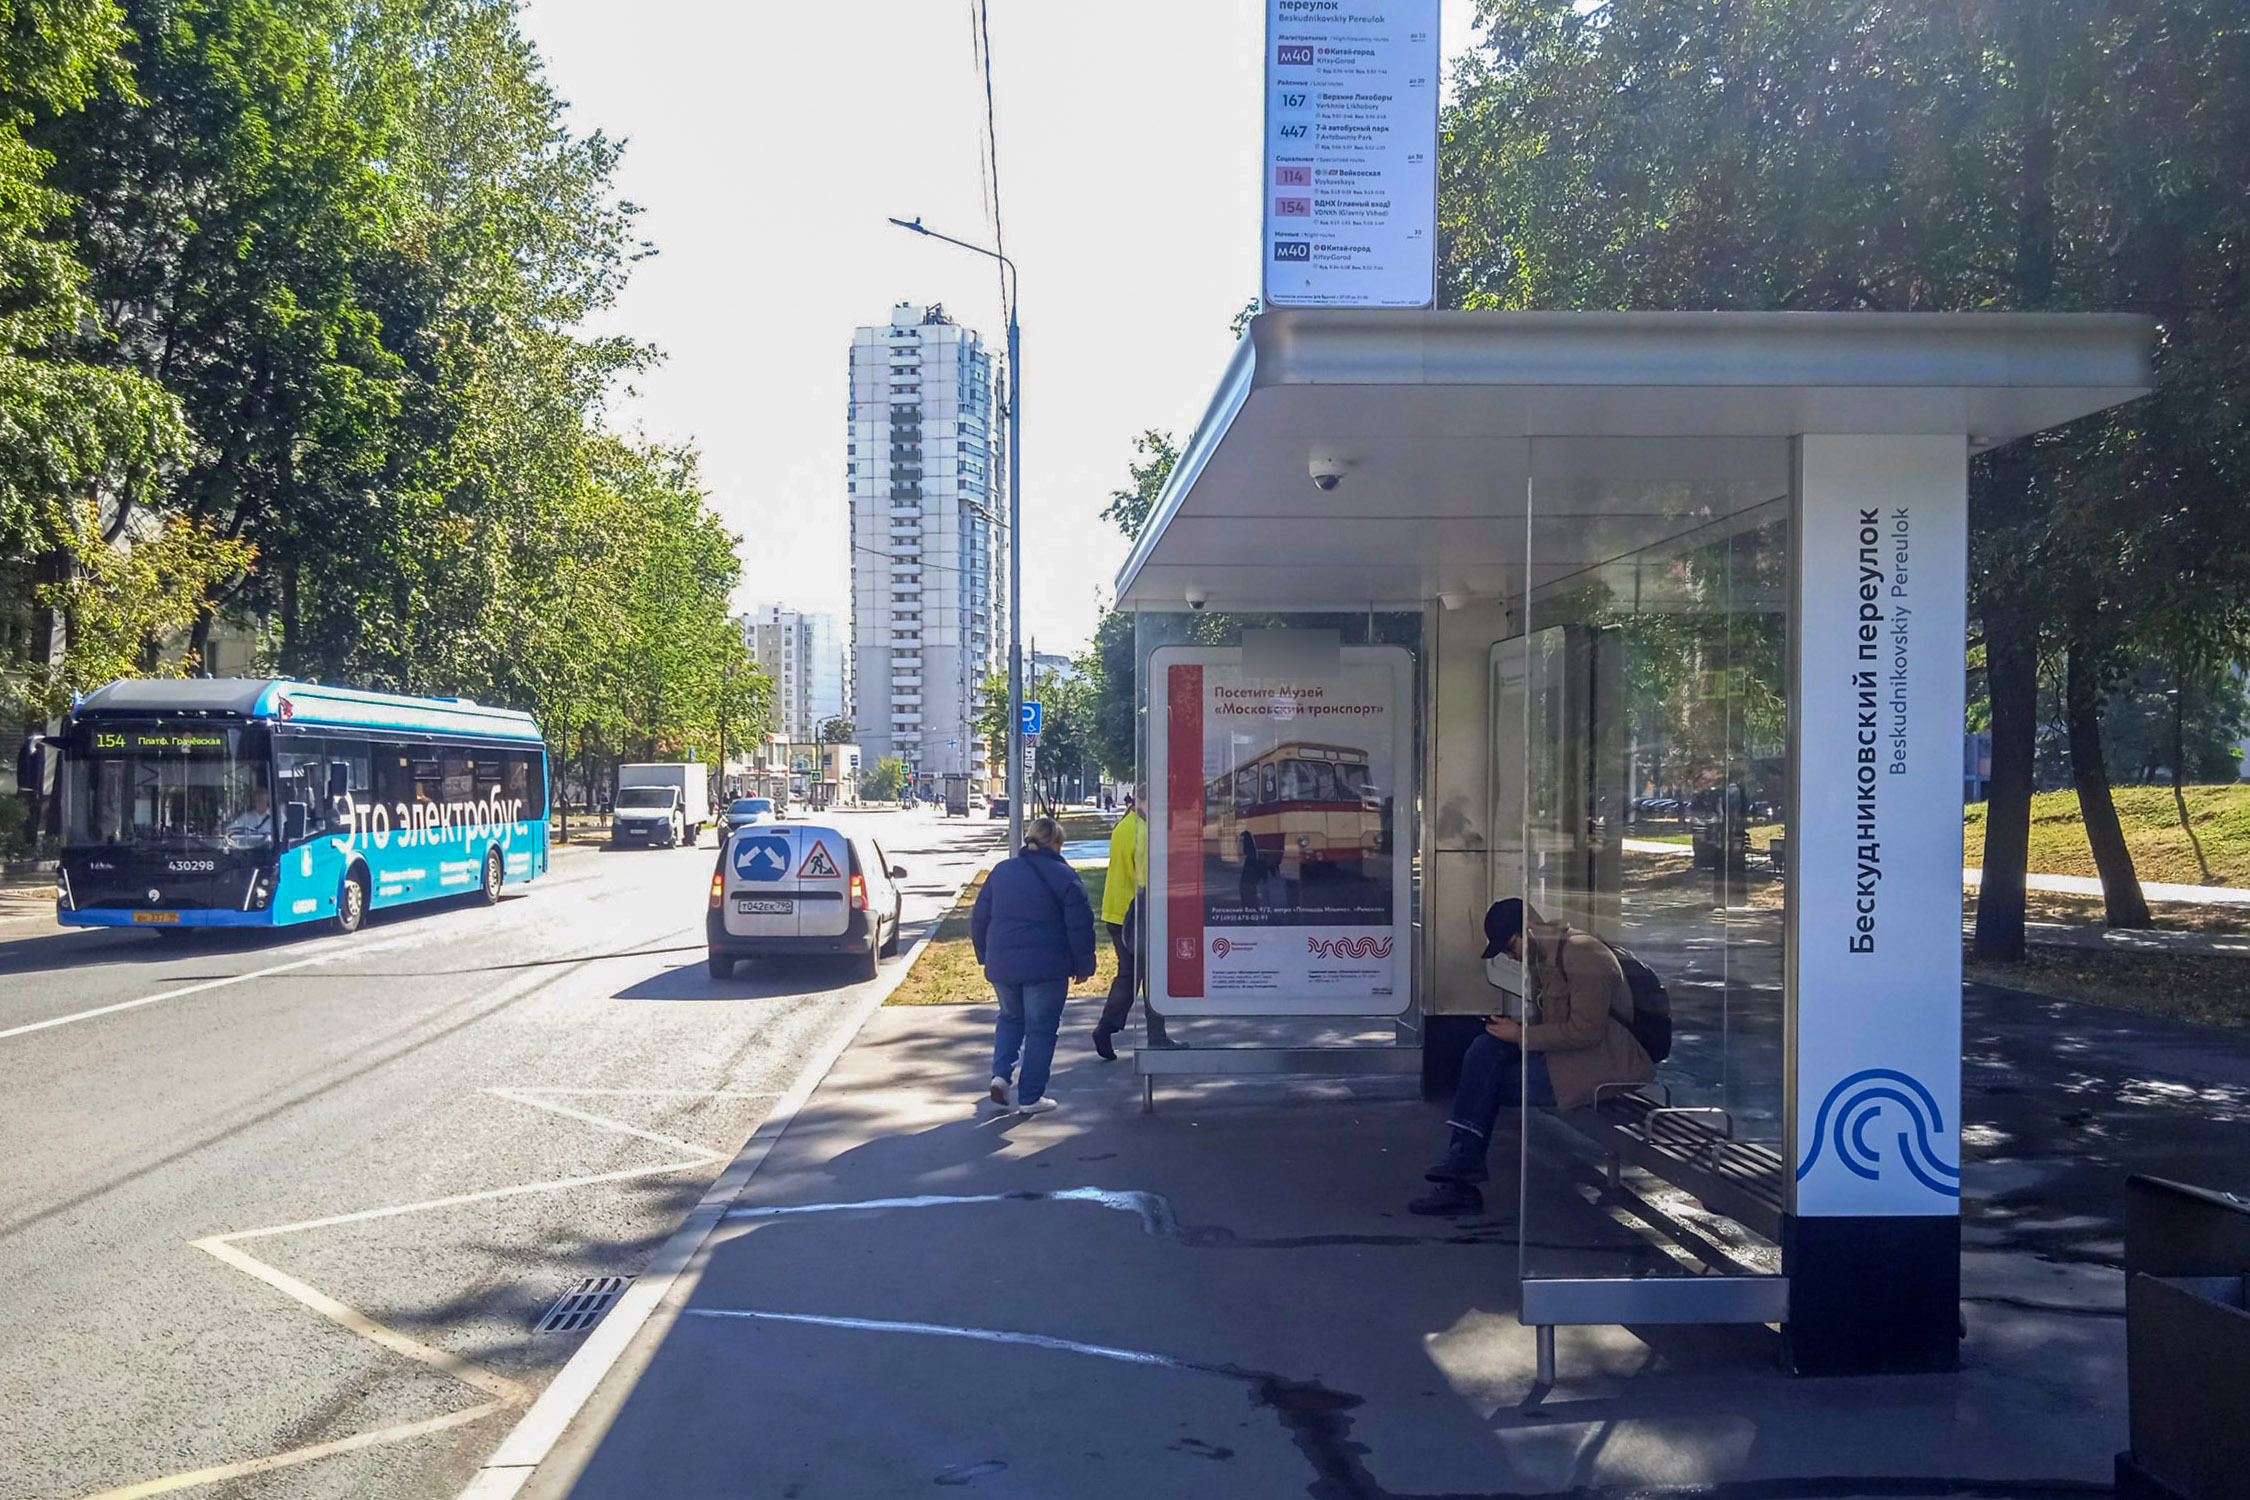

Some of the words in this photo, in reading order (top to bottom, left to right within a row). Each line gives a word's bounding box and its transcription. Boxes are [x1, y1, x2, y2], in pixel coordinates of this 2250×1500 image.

[1279, 0, 1338, 12] переулок
[1279, 14, 1347, 24] Beskudnikovskiy
[1349, 15, 1385, 23] Pereulok
[1280, 49, 1311, 62] м40
[1330, 48, 1375, 57] Китай-город
[1282, 94, 1306, 107] 167
[1323, 93, 1353, 102] Верхние
[1354, 93, 1392, 101] Лихоборы
[1280, 125, 1307, 138] 447
[1328, 124, 1370, 133] автобусный
[1276, 155, 1314, 163] Социальные
[1283, 171, 1303, 183] 114
[1339, 169, 1381, 177] Войковская
[1281, 201, 1305, 214] 154
[1315, 200, 1336, 208] ВДНХ
[1337, 199, 1369, 208] (главный
[1371, 200, 1391, 208] вход)
[1277, 245, 1307, 257] м40
[1327, 244, 1371, 253] Китай-город
[1891, 507, 1909, 598] Pereulok
[1859, 508, 1884, 661] переулок
[1214, 686, 1275, 698] Посетите
[1279, 686, 1323, 700] Музей
[1889, 605, 1911, 775] Beskudnikovskiy
[1308, 704, 1384, 717] транспорт»
[97, 734, 126, 748] 154
[138, 737, 169, 745] Платф.
[1850, 671, 1881, 954] Бескудниковский
[331, 791, 390, 853] Это
[396, 785, 528, 854] электробус.
[168, 861, 215, 871] 430298
